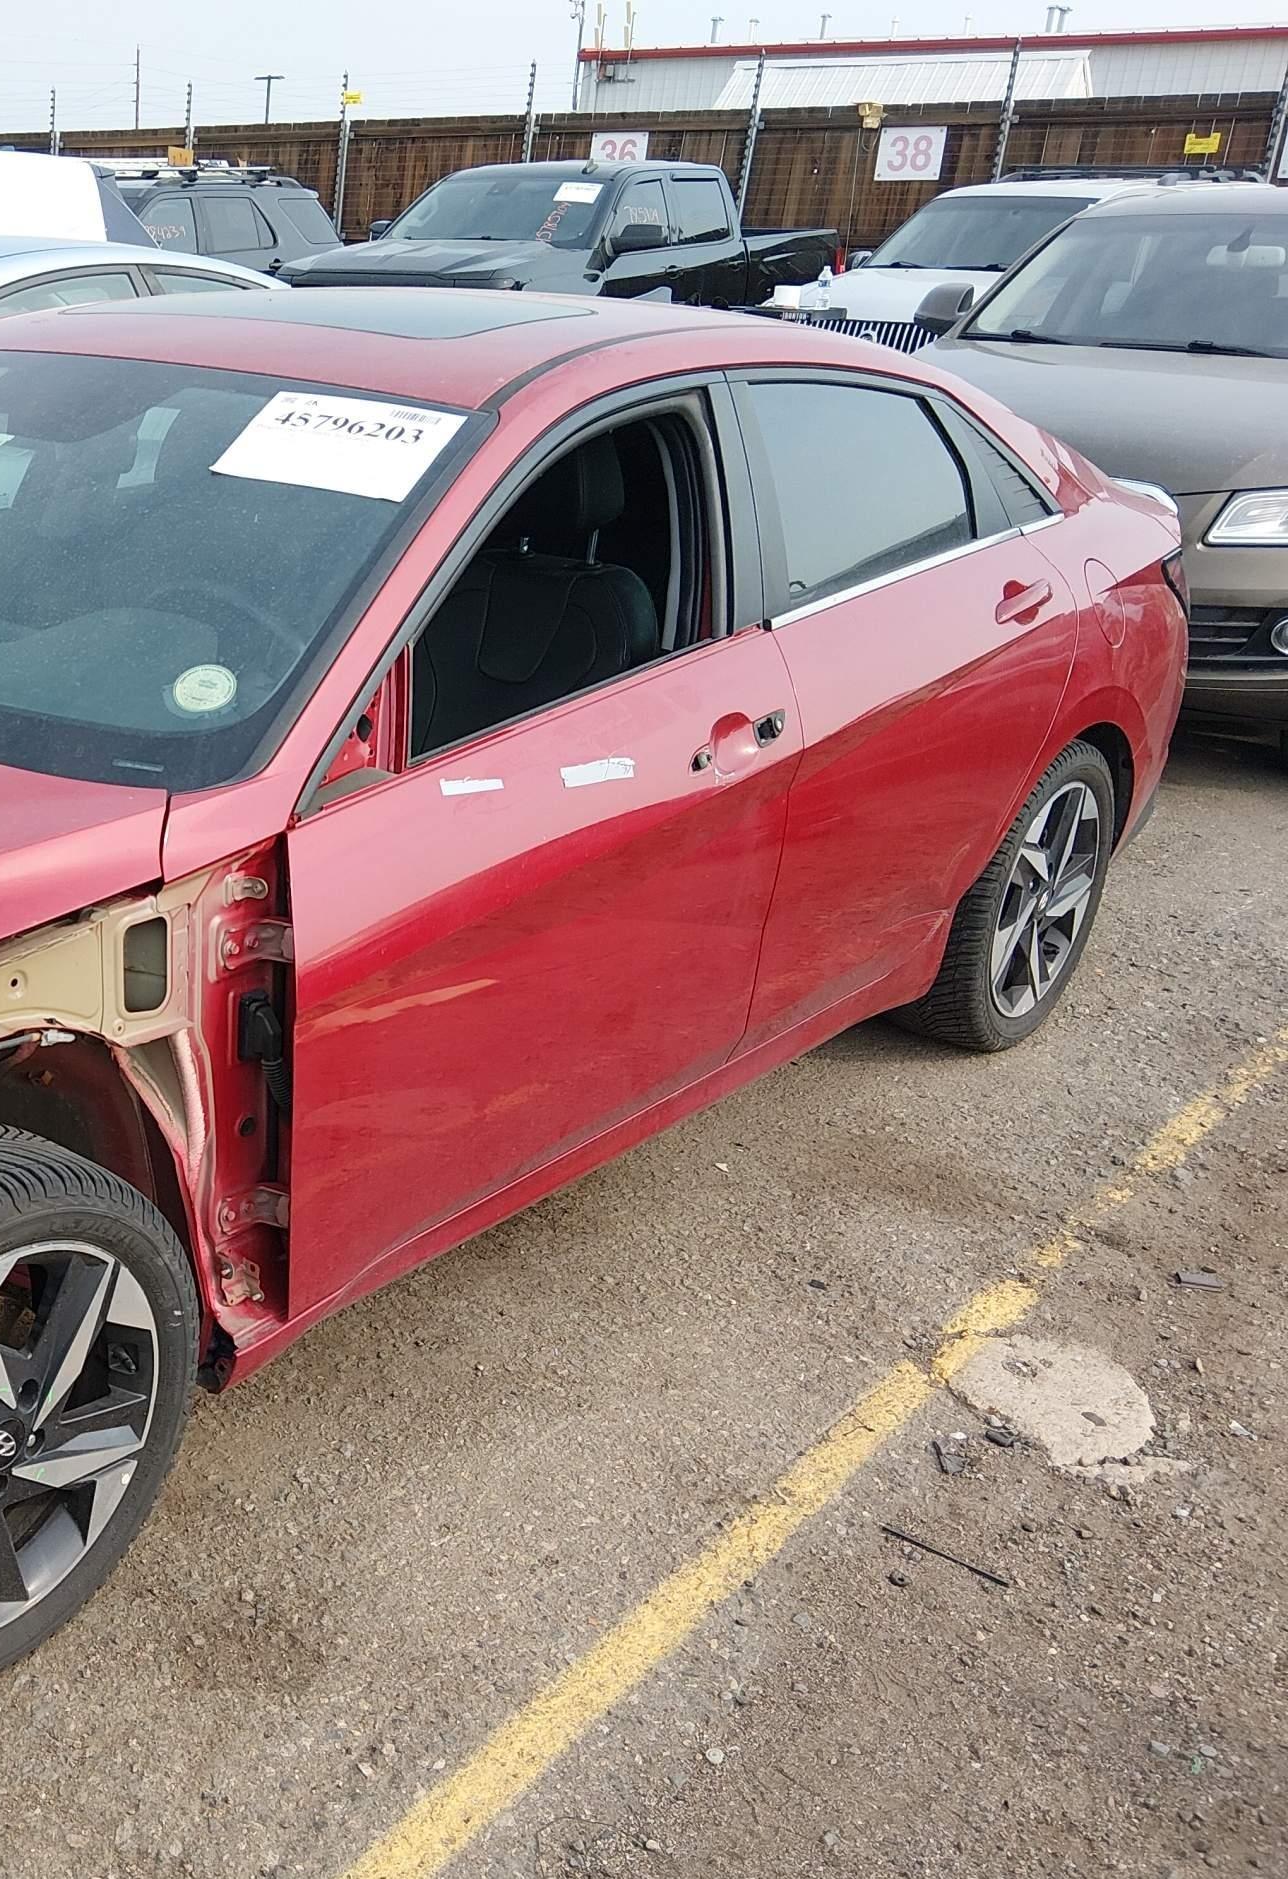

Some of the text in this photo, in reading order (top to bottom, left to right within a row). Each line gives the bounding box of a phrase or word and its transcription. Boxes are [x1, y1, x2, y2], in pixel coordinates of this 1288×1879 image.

[600, 138, 638, 161] 36
[886, 134, 933, 172] 38
[274, 409, 425, 445] 45796203
